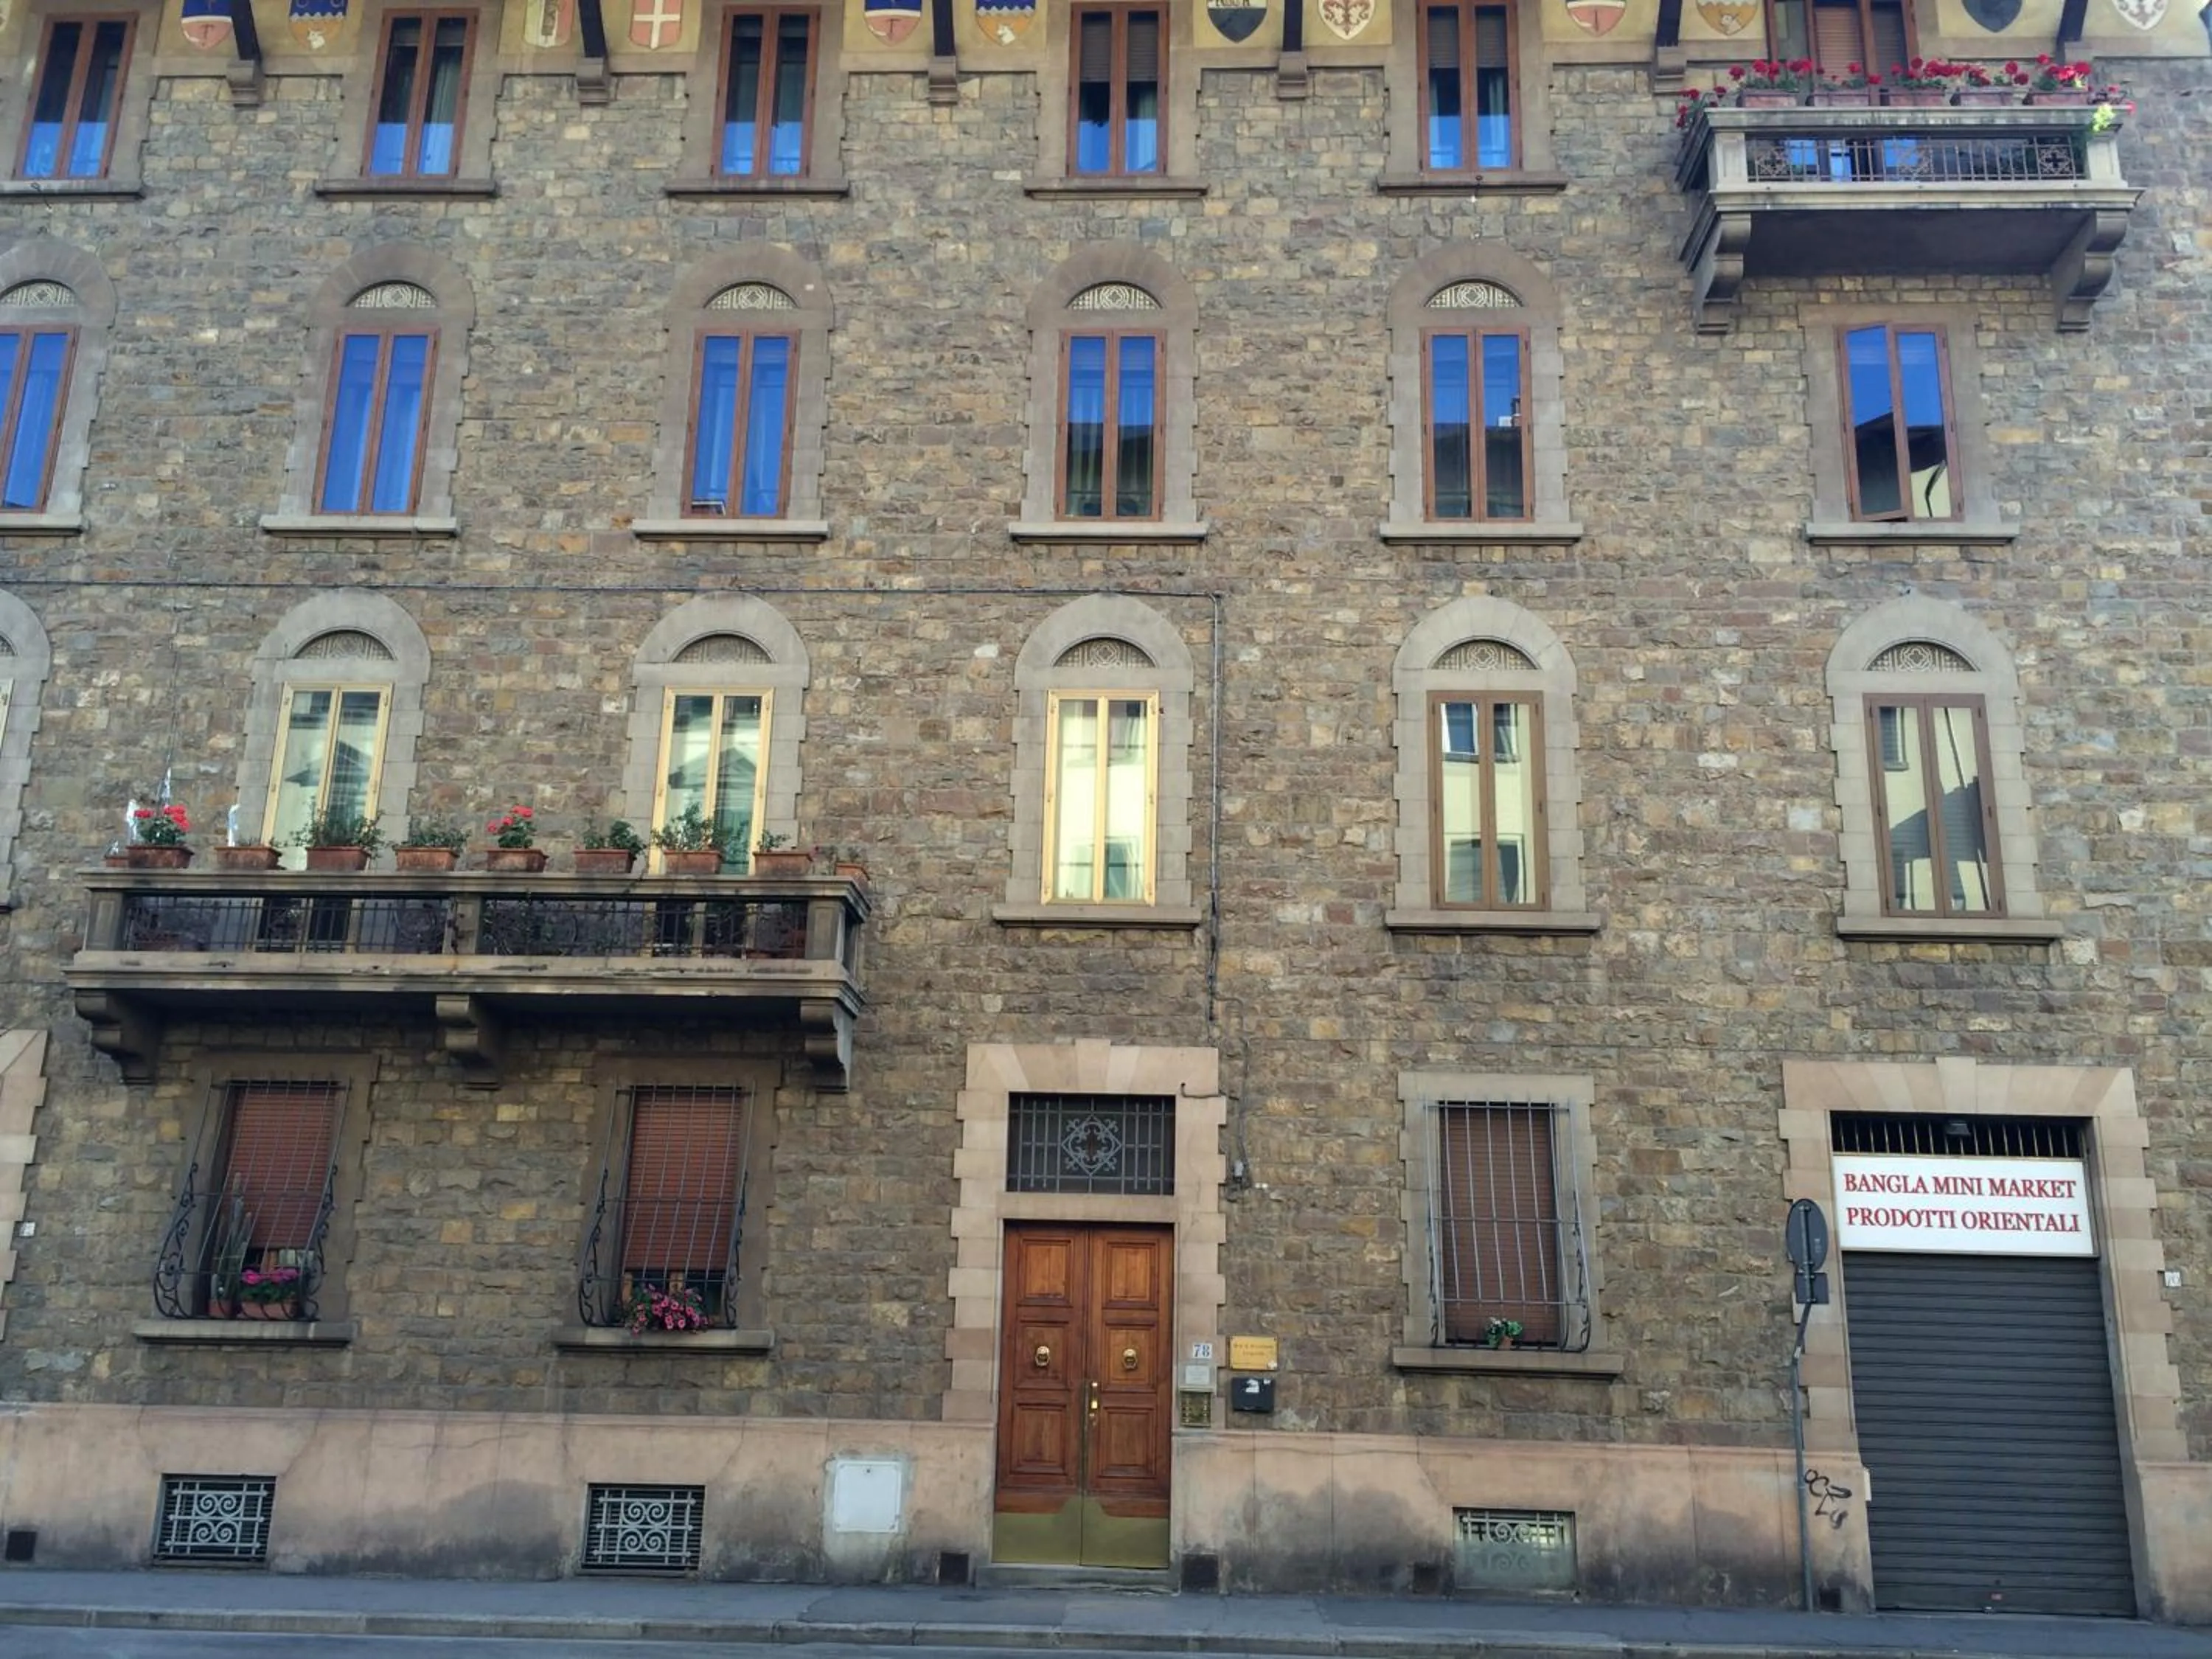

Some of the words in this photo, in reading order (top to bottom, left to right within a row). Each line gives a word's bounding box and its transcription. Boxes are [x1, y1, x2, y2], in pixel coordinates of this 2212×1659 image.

[1844, 1173, 1928, 1194] BANGLA
[1933, 1176, 1983, 1196] MINI
[1989, 1178, 2076, 1198] MARKET
[1846, 1207, 1956, 1228] PRODOTTI
[1961, 1211, 2081, 1232] ORIENTALI
[1194, 1344, 1210, 1357] 78
